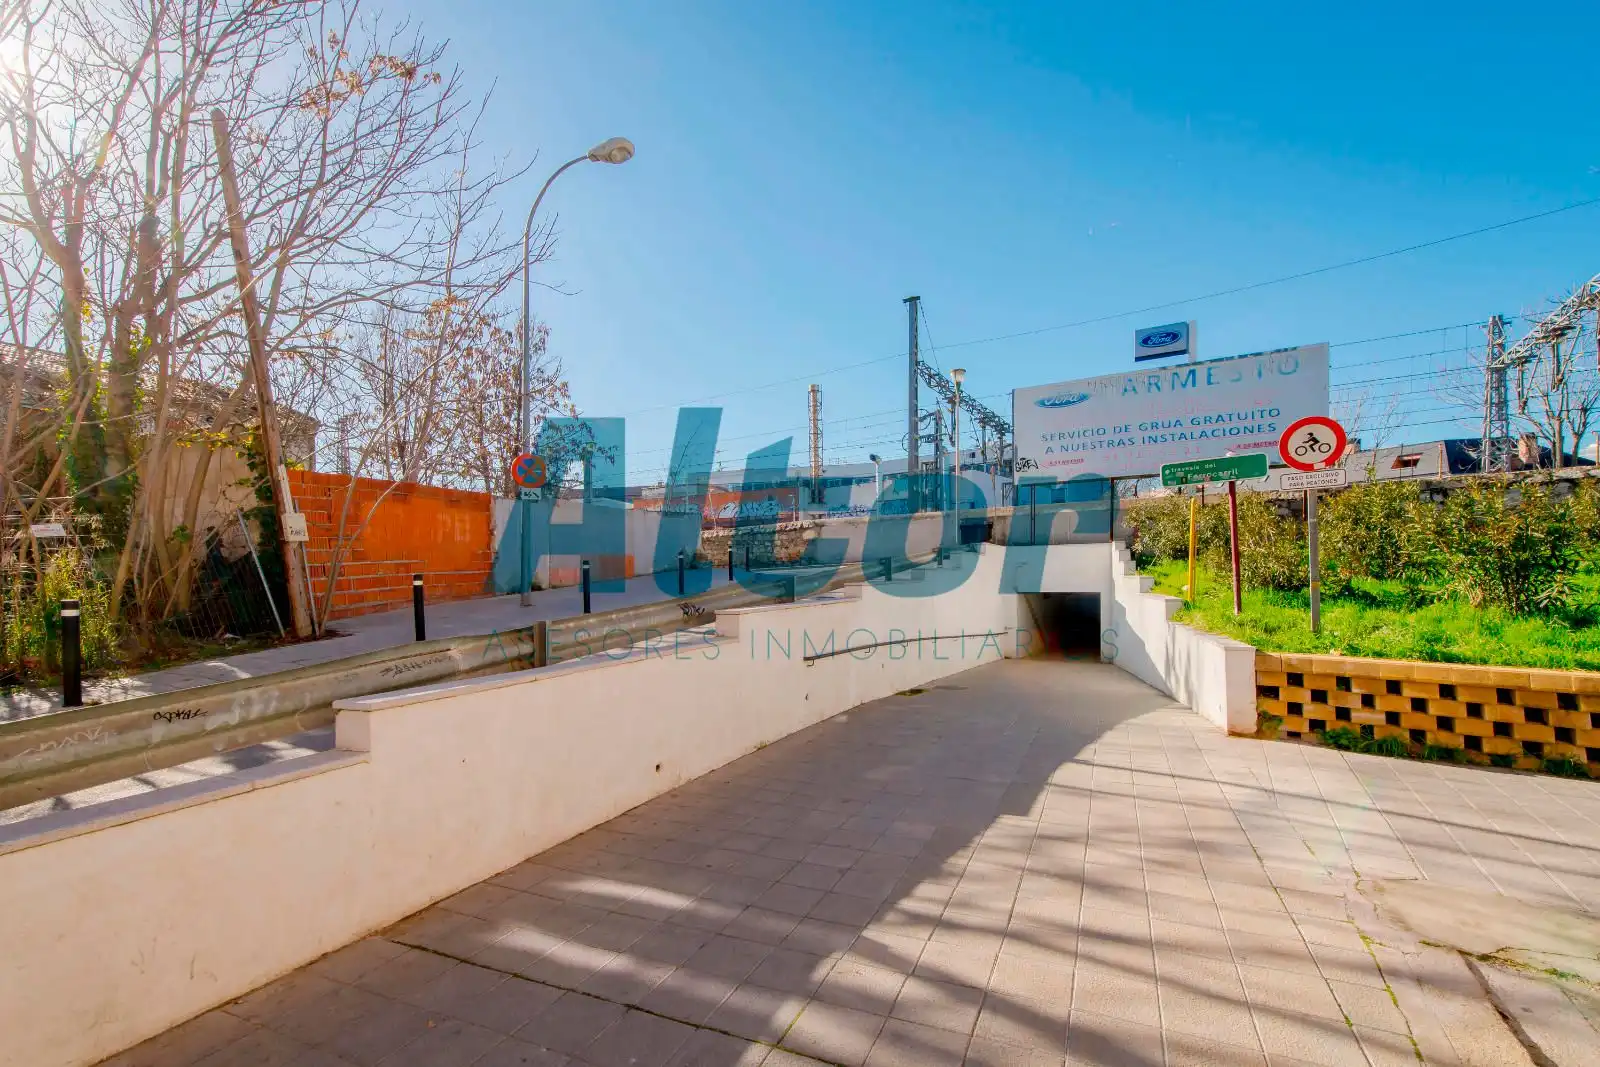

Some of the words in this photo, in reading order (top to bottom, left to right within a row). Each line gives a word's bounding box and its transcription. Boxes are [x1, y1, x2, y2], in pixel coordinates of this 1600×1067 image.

[1040, 427, 1106, 442] SERVICIO
[1113, 424, 1132, 434] DE
[1138, 418, 1184, 432] GRUA
[1190, 408, 1281, 426] GRATUITO
[1044, 446, 1054, 455] A
[1060, 437, 1135, 452] NUESTRAS
[1142, 423, 1277, 444] INSTALACIONES
[1305, 471, 1339, 480] EXCLUSIVO
[1306, 478, 1338, 486] PEATONES
